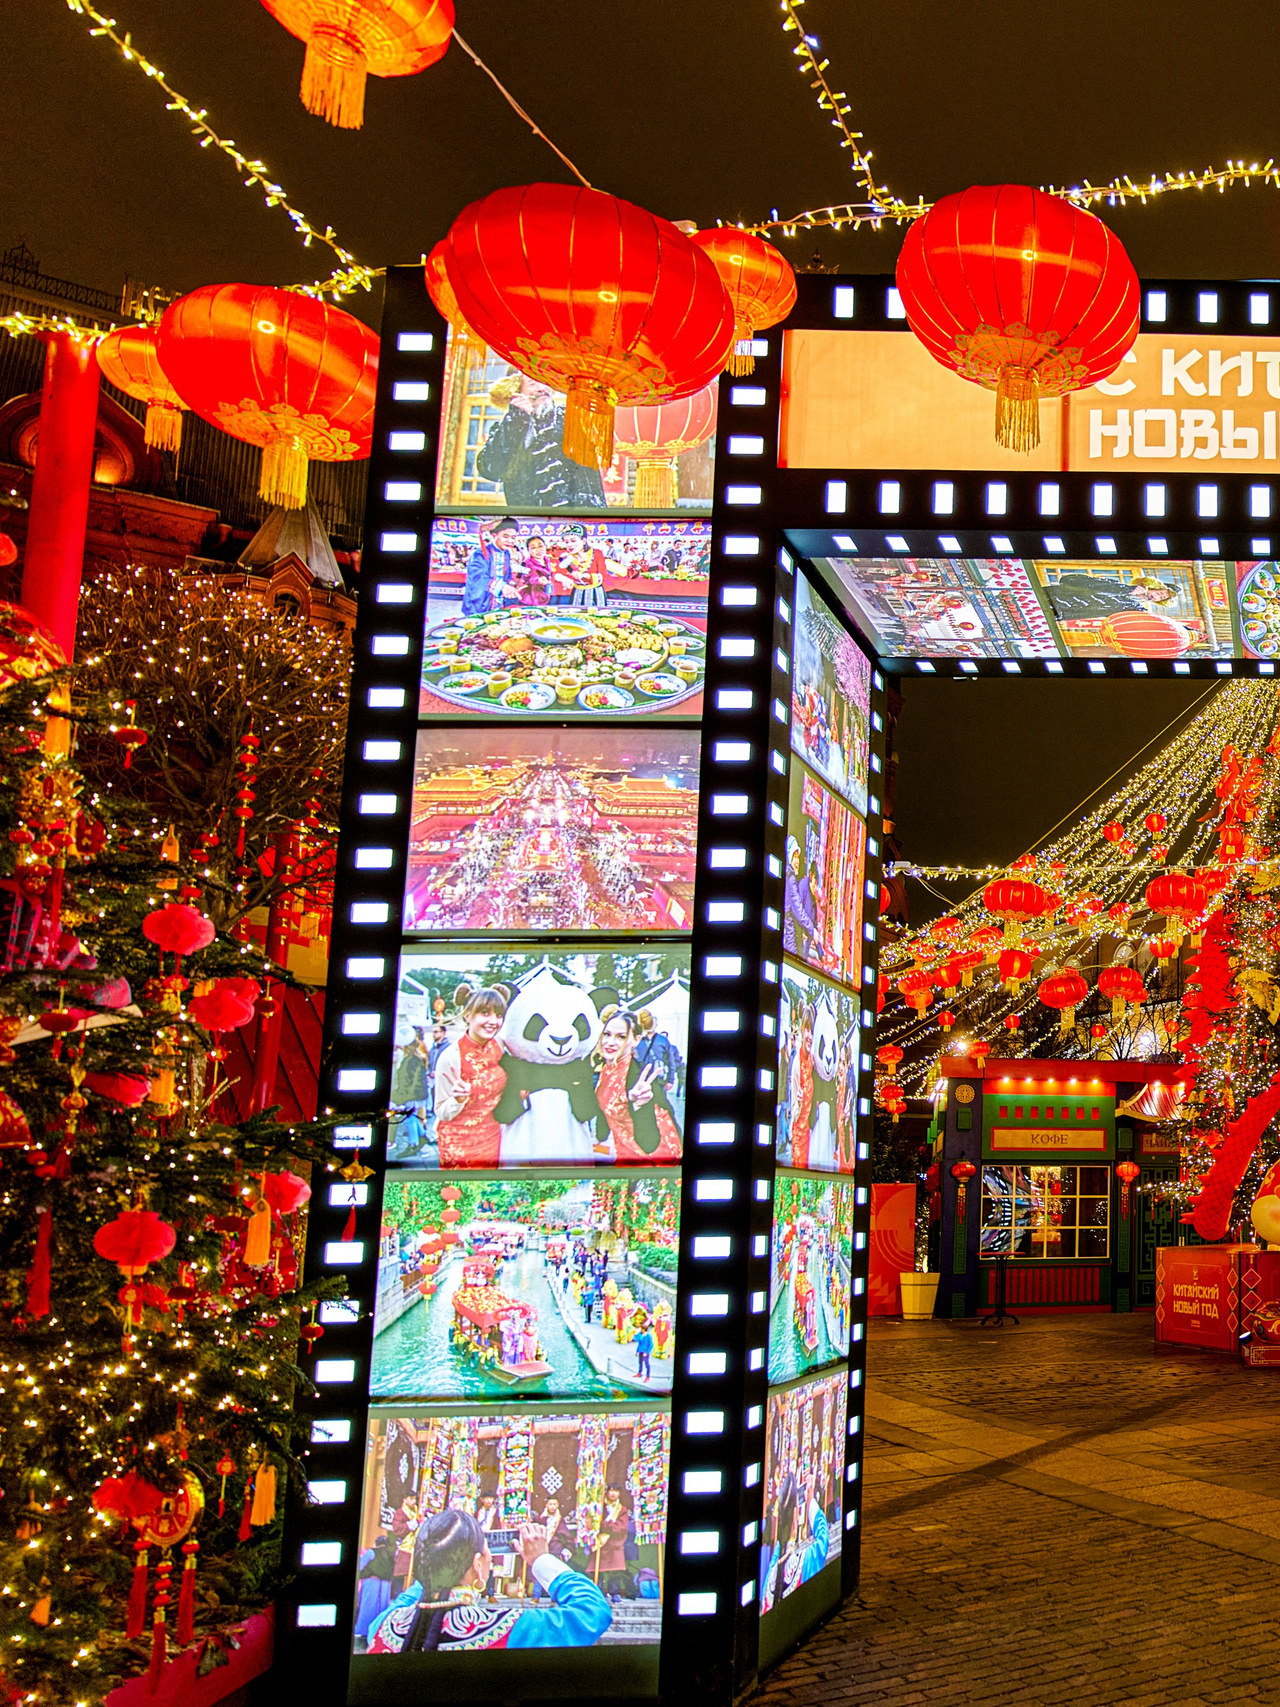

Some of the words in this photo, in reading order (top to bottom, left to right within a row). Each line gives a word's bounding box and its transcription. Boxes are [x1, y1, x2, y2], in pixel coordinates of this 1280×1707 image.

[1030, 1133, 1069, 1145] КОФЕ
[1173, 1282, 1219, 1300] КИТАЙСКИЙ
[1173, 1299, 1200, 1315] НОВЫЙ
[1201, 1303, 1219, 1319] ГОД
